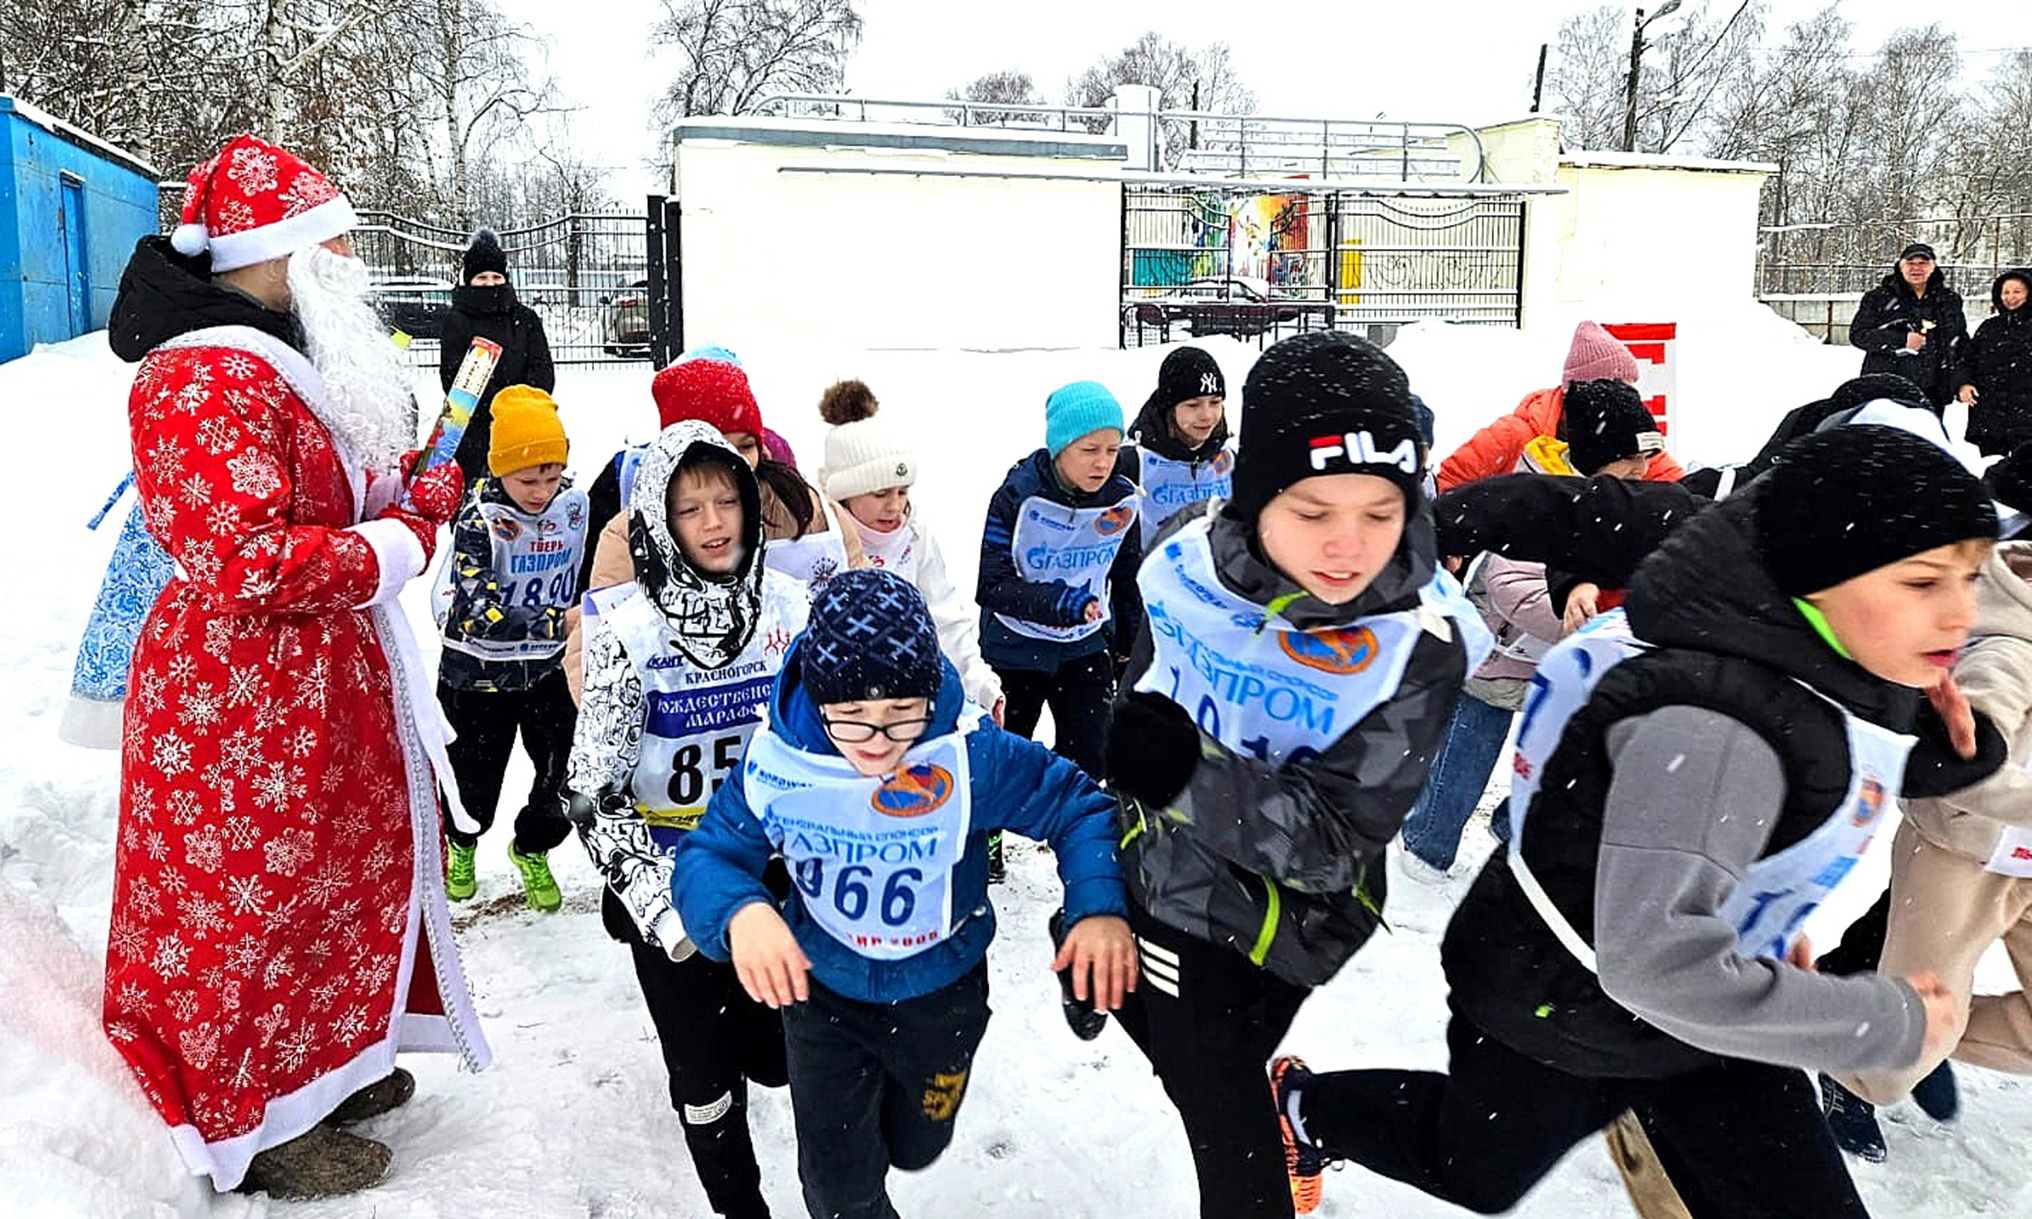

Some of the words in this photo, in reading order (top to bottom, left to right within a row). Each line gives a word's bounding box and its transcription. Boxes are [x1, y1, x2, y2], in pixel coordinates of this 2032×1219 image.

[1308, 430, 1417, 474] FILA
[530, 540, 564, 552] ТВЕРЬ
[511, 547, 572, 574] ГАЗПРОМ
[685, 660, 767, 684] КРАСНОГОРСК
[685, 702, 760, 728] МАРАФО
